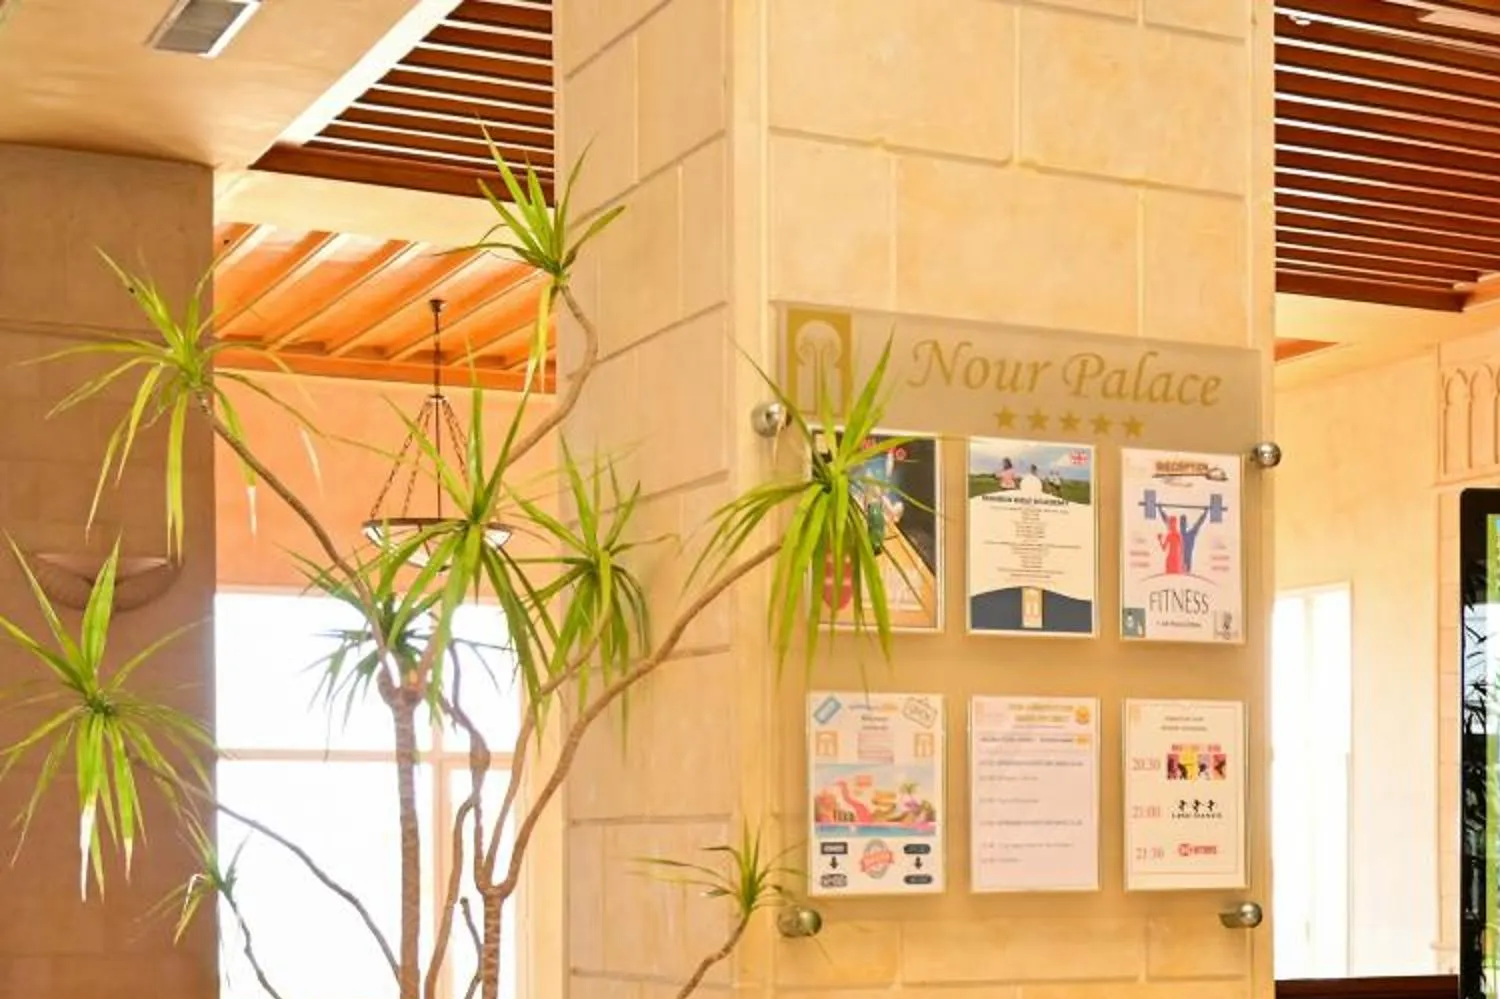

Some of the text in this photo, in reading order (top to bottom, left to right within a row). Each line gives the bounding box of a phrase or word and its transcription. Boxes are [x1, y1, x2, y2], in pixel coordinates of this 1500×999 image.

[907, 339, 1222, 406] Nour Palace
[1149, 589, 1210, 615] FITNESS
